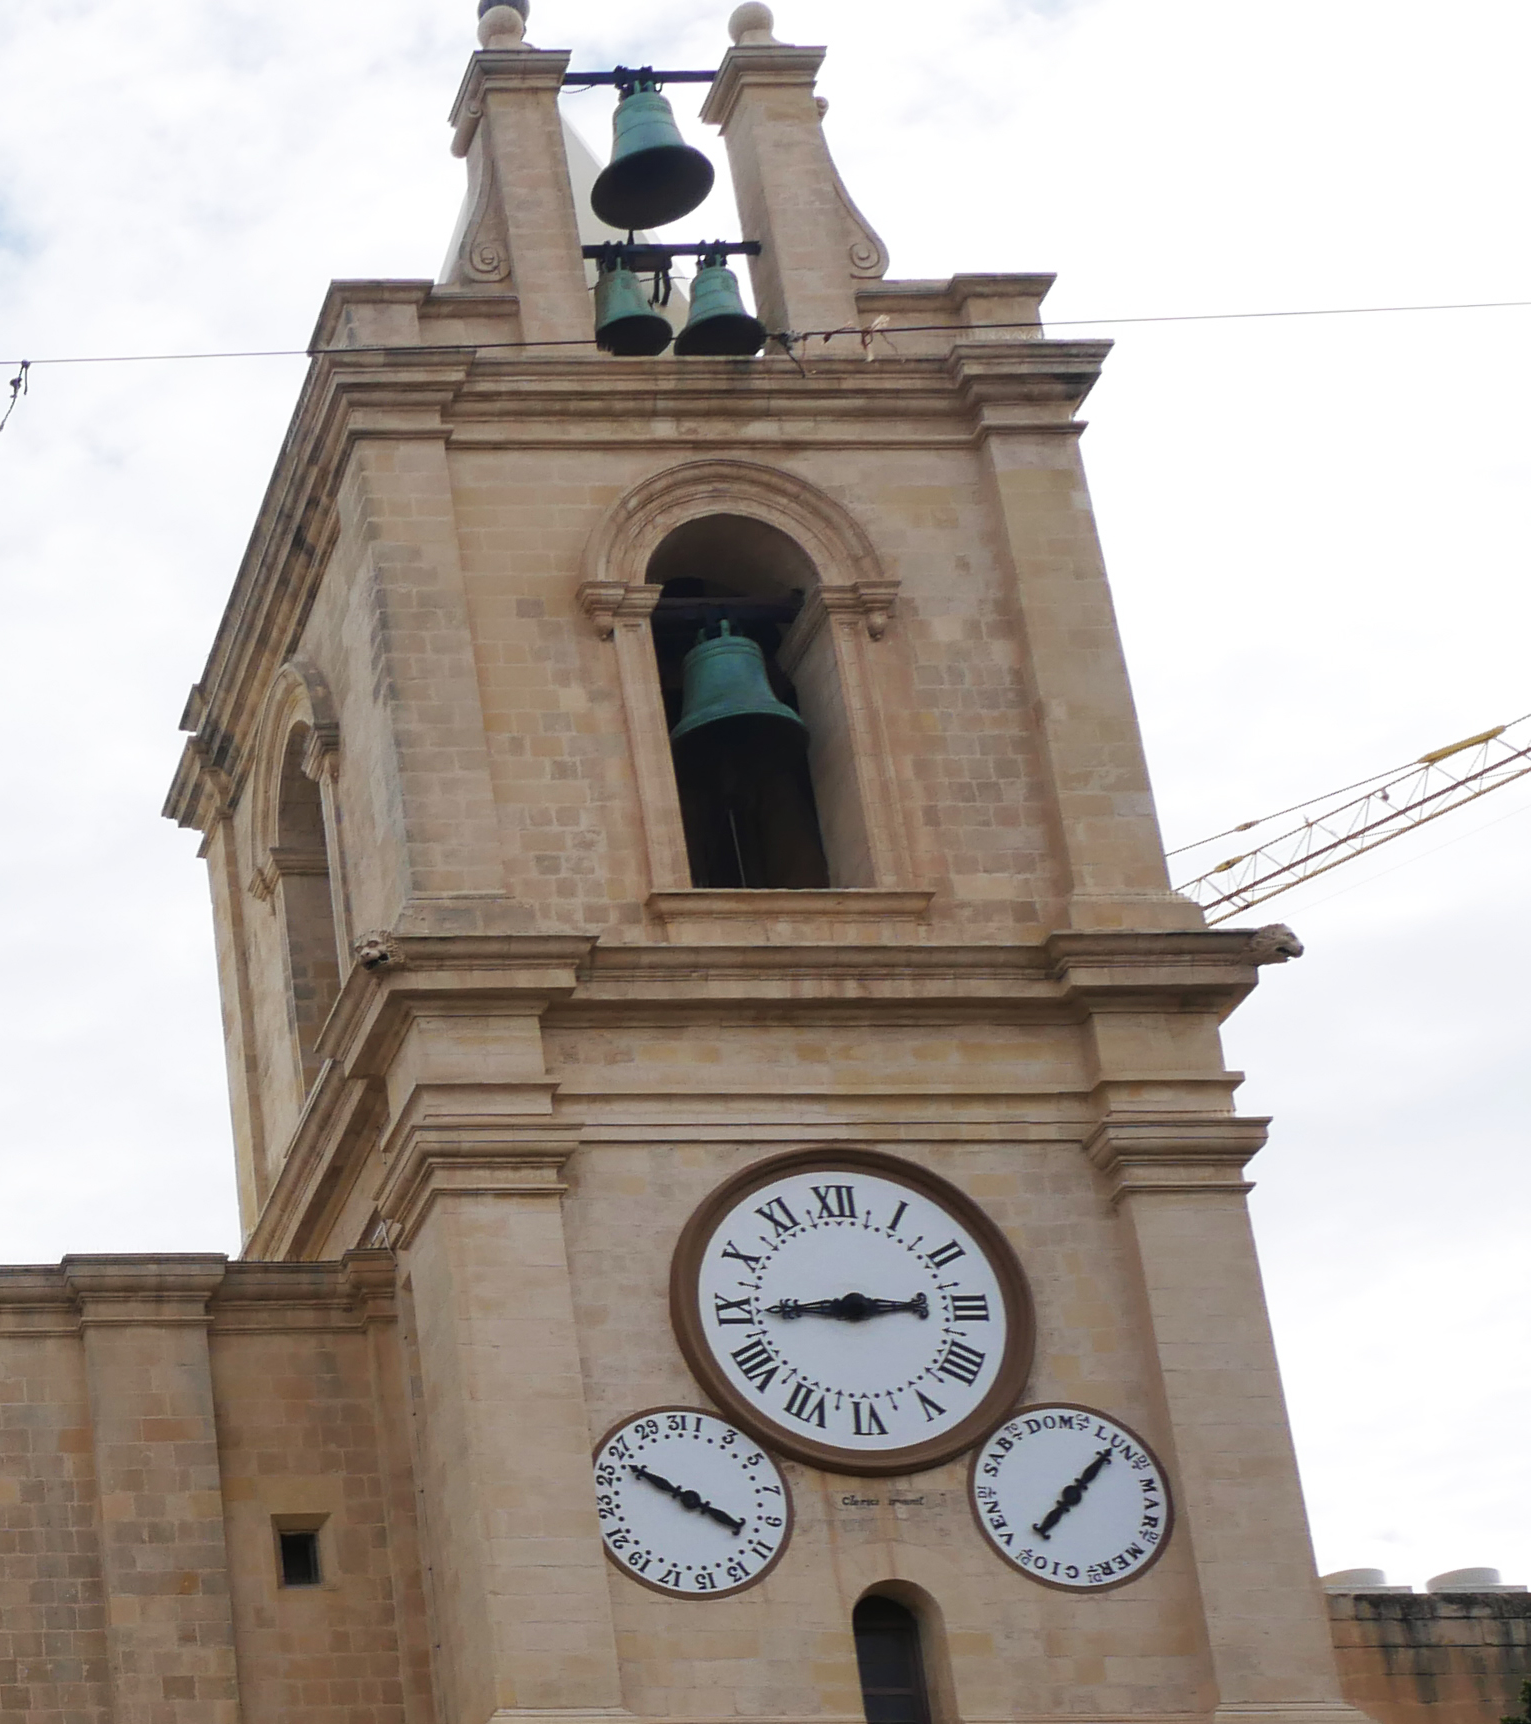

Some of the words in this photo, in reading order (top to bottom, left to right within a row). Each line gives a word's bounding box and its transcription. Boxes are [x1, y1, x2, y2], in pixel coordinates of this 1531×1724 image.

[810, 1184, 859, 1220] XII
[754, 1196, 802, 1239] XI
[887, 1200, 908, 1233] I
[721, 1239, 763, 1273] X
[925, 1238, 967, 1269] II
[714, 1292, 755, 1327] IX
[950, 1294, 990, 1322] III
[730, 1338, 781, 1394] VIII
[938, 1338, 986, 1387] IIII
[783, 1380, 827, 1429] VII
[914, 1388, 947, 1422] V
[634, 1419, 659, 1440] 29
[666, 1414, 688, 1432] 31
[852, 1401, 889, 1436] VI
[608, 1435, 632, 1461] 27
[721, 1429, 739, 1445] 3
[747, 1452, 764, 1466] 5
[596, 1462, 616, 1488] 25
[762, 1485, 781, 1496] 7
[597, 1494, 616, 1520] 23
[765, 1515, 782, 1528] 9
[605, 1527, 631, 1550] 21
[751, 1540, 774, 1561] 11
[628, 1551, 653, 1574] 19
[726, 1561, 752, 1583] 13
[657, 1569, 682, 1588] 17
[695, 1572, 717, 1590] 15
